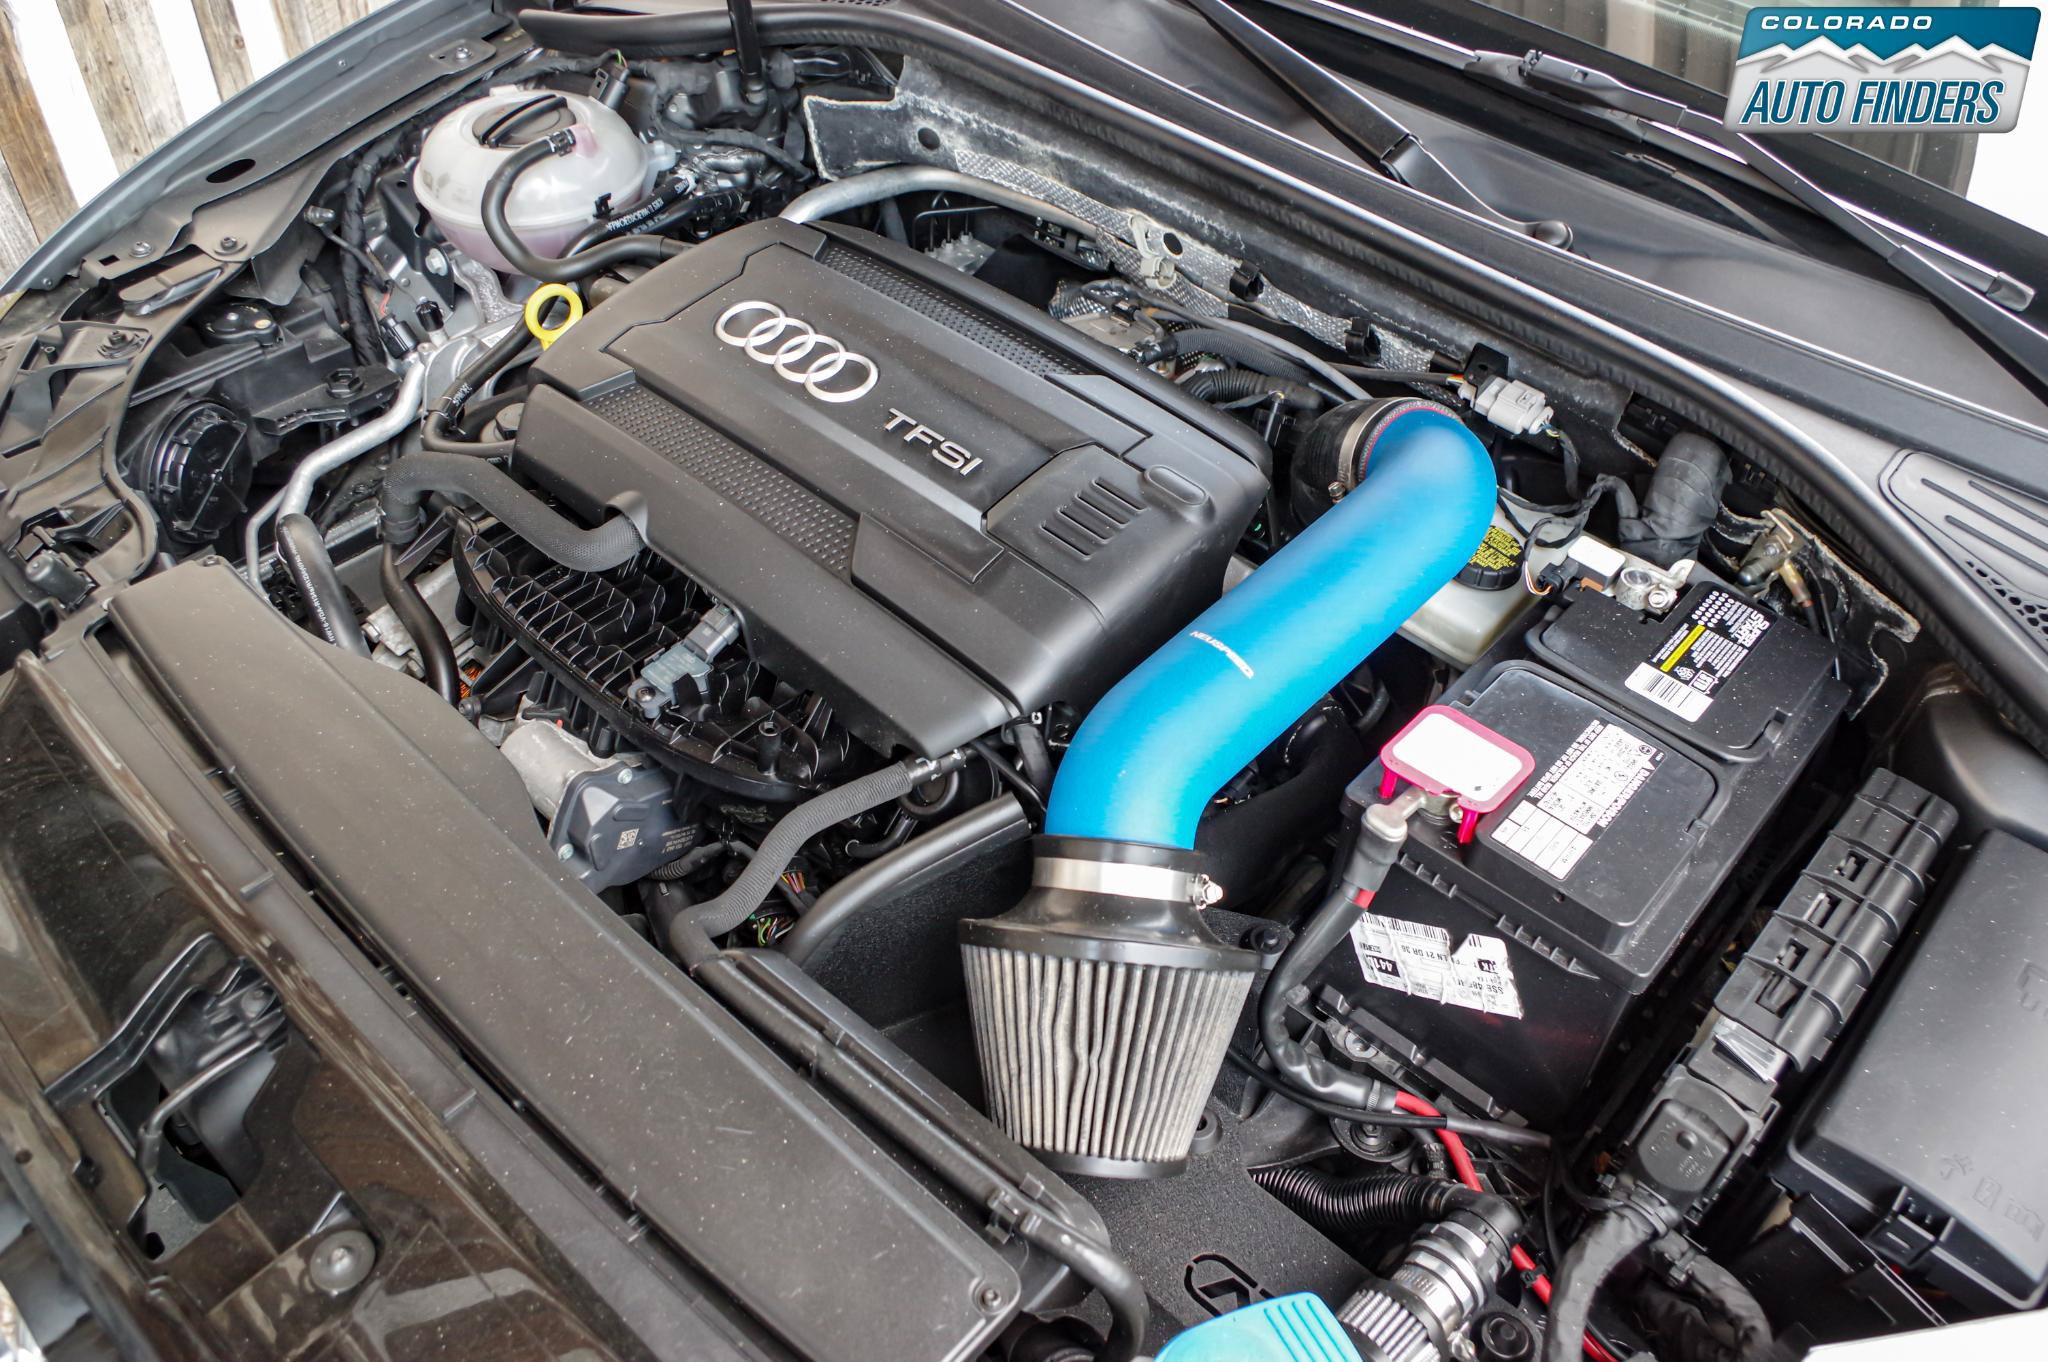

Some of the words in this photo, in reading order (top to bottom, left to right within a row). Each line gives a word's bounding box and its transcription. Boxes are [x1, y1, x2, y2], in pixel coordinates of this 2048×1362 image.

[884, 407, 984, 477] TFSI
[1736, 610, 1765, 645] START
[1742, 620, 1771, 648] SUPER
[1190, 631, 1254, 680] NEUSPEED
